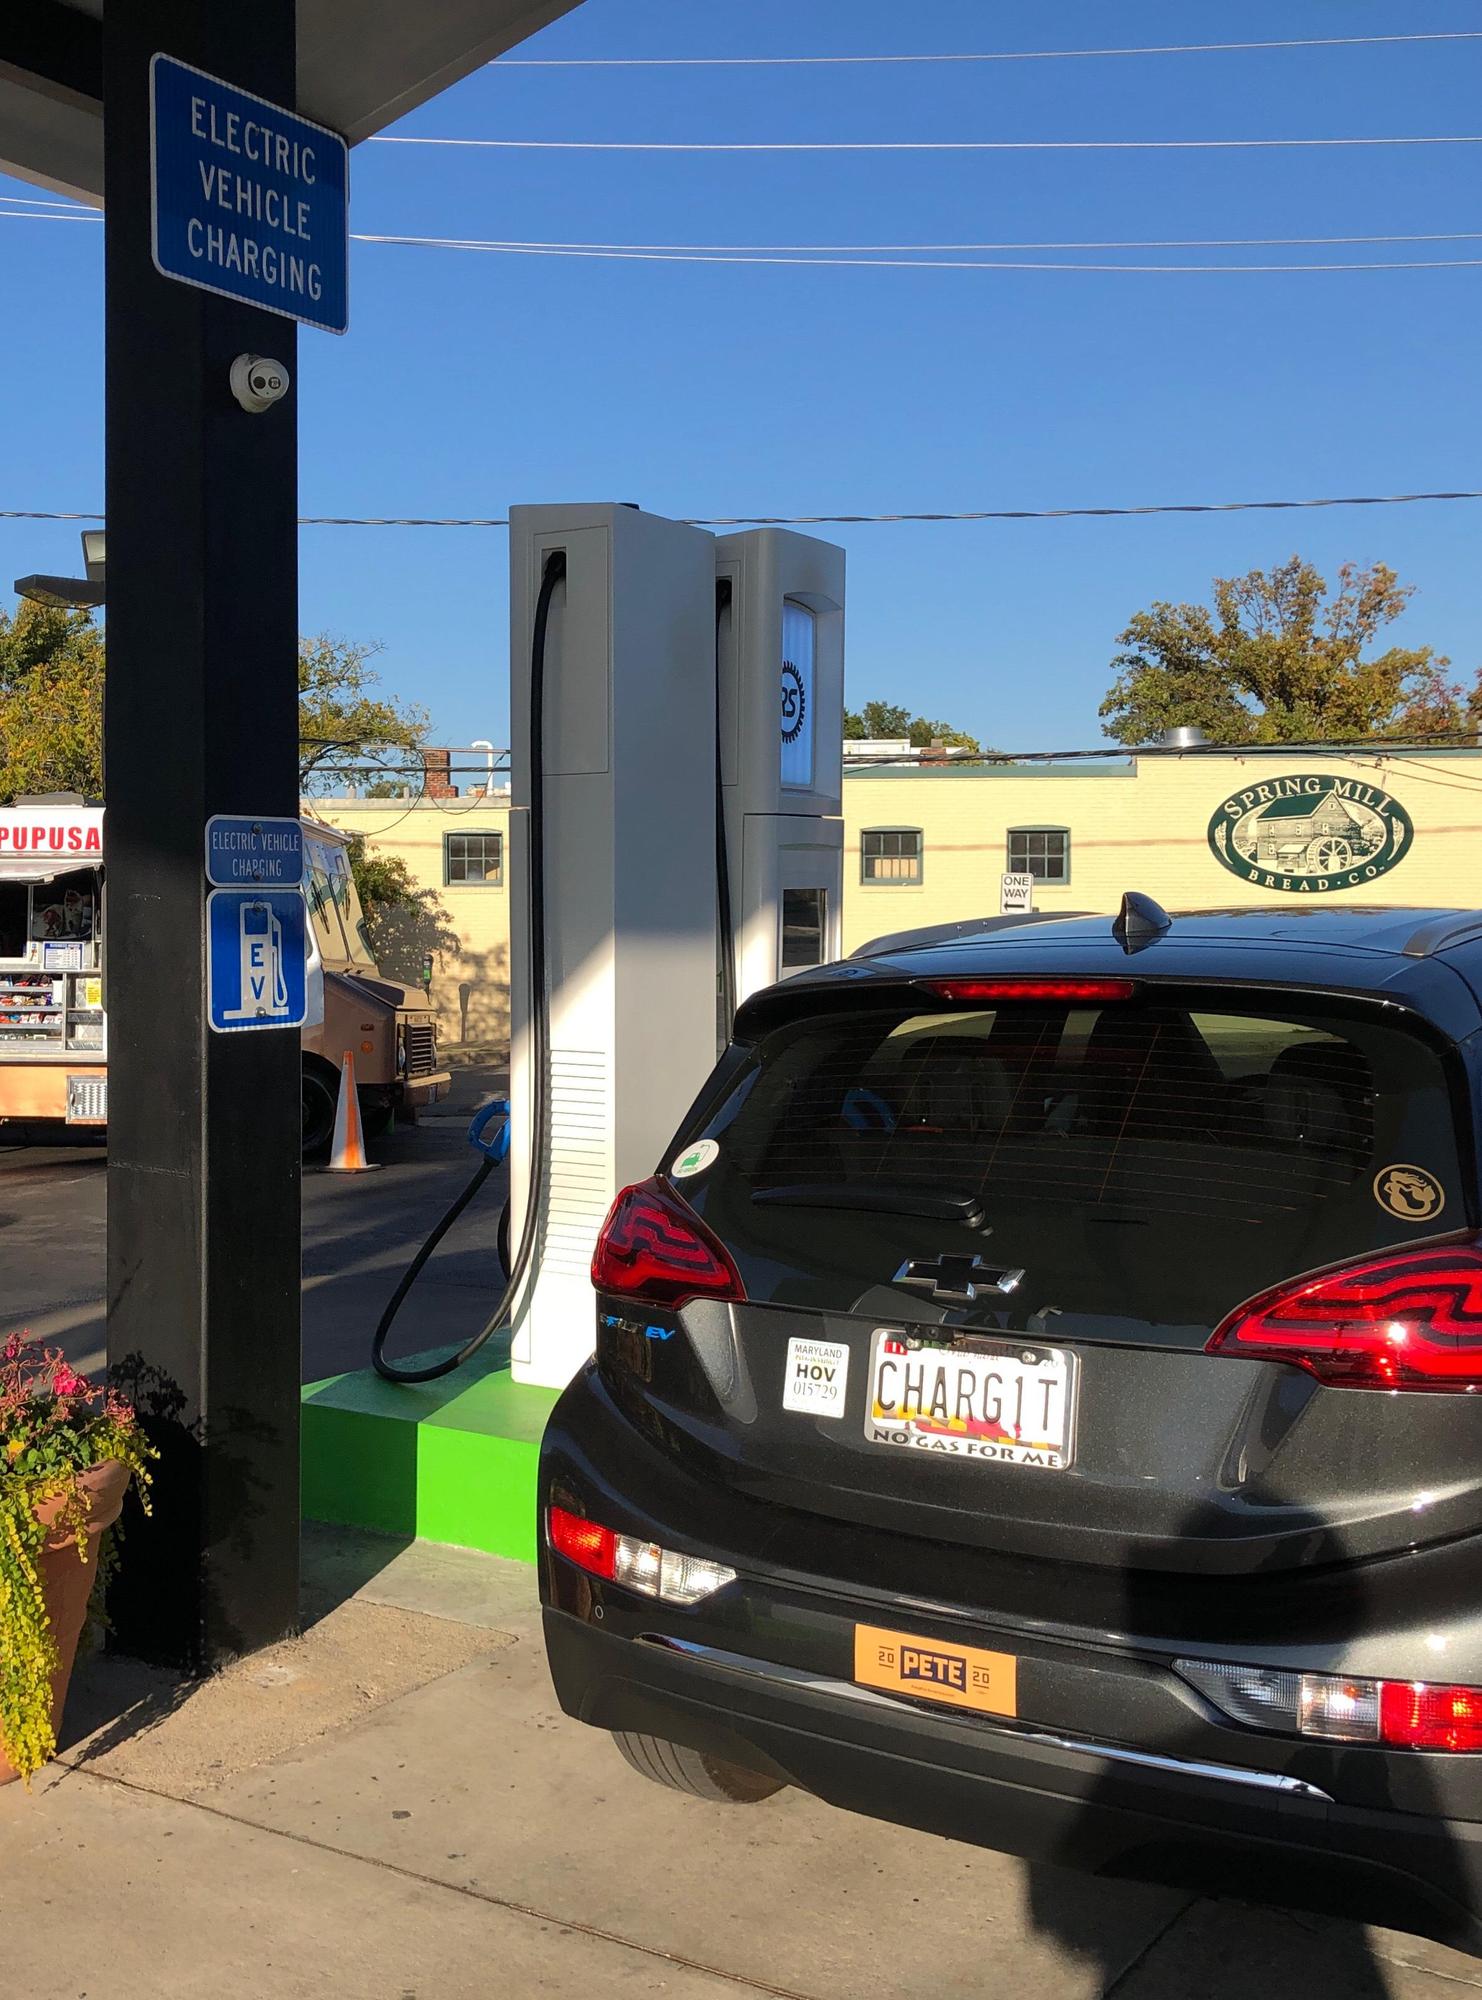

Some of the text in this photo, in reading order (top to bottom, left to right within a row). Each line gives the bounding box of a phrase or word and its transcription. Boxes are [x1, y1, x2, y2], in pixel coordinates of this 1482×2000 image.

[190, 96, 316, 185] ELECTRIC
[199, 160, 311, 241] VEHICLE
[187, 218, 322, 301] CHARGING
[1223, 777, 1395, 820] SPRING MILL
[212, 831, 300, 851] ELECTRIC VEHICLE
[1004, 876, 1030, 886] ONE
[1248, 869, 1330, 891] BREAD
[1004, 888, 1029, 898] WAY
[645, 1326, 676, 1340] EV
[794, 1344, 843, 1359] MARYLAND
[796, 1363, 837, 1382] HOV
[872, 1429, 1058, 1468] NO GAS FOR ME
[878, 1650, 990, 1686] 20 PETE 20
